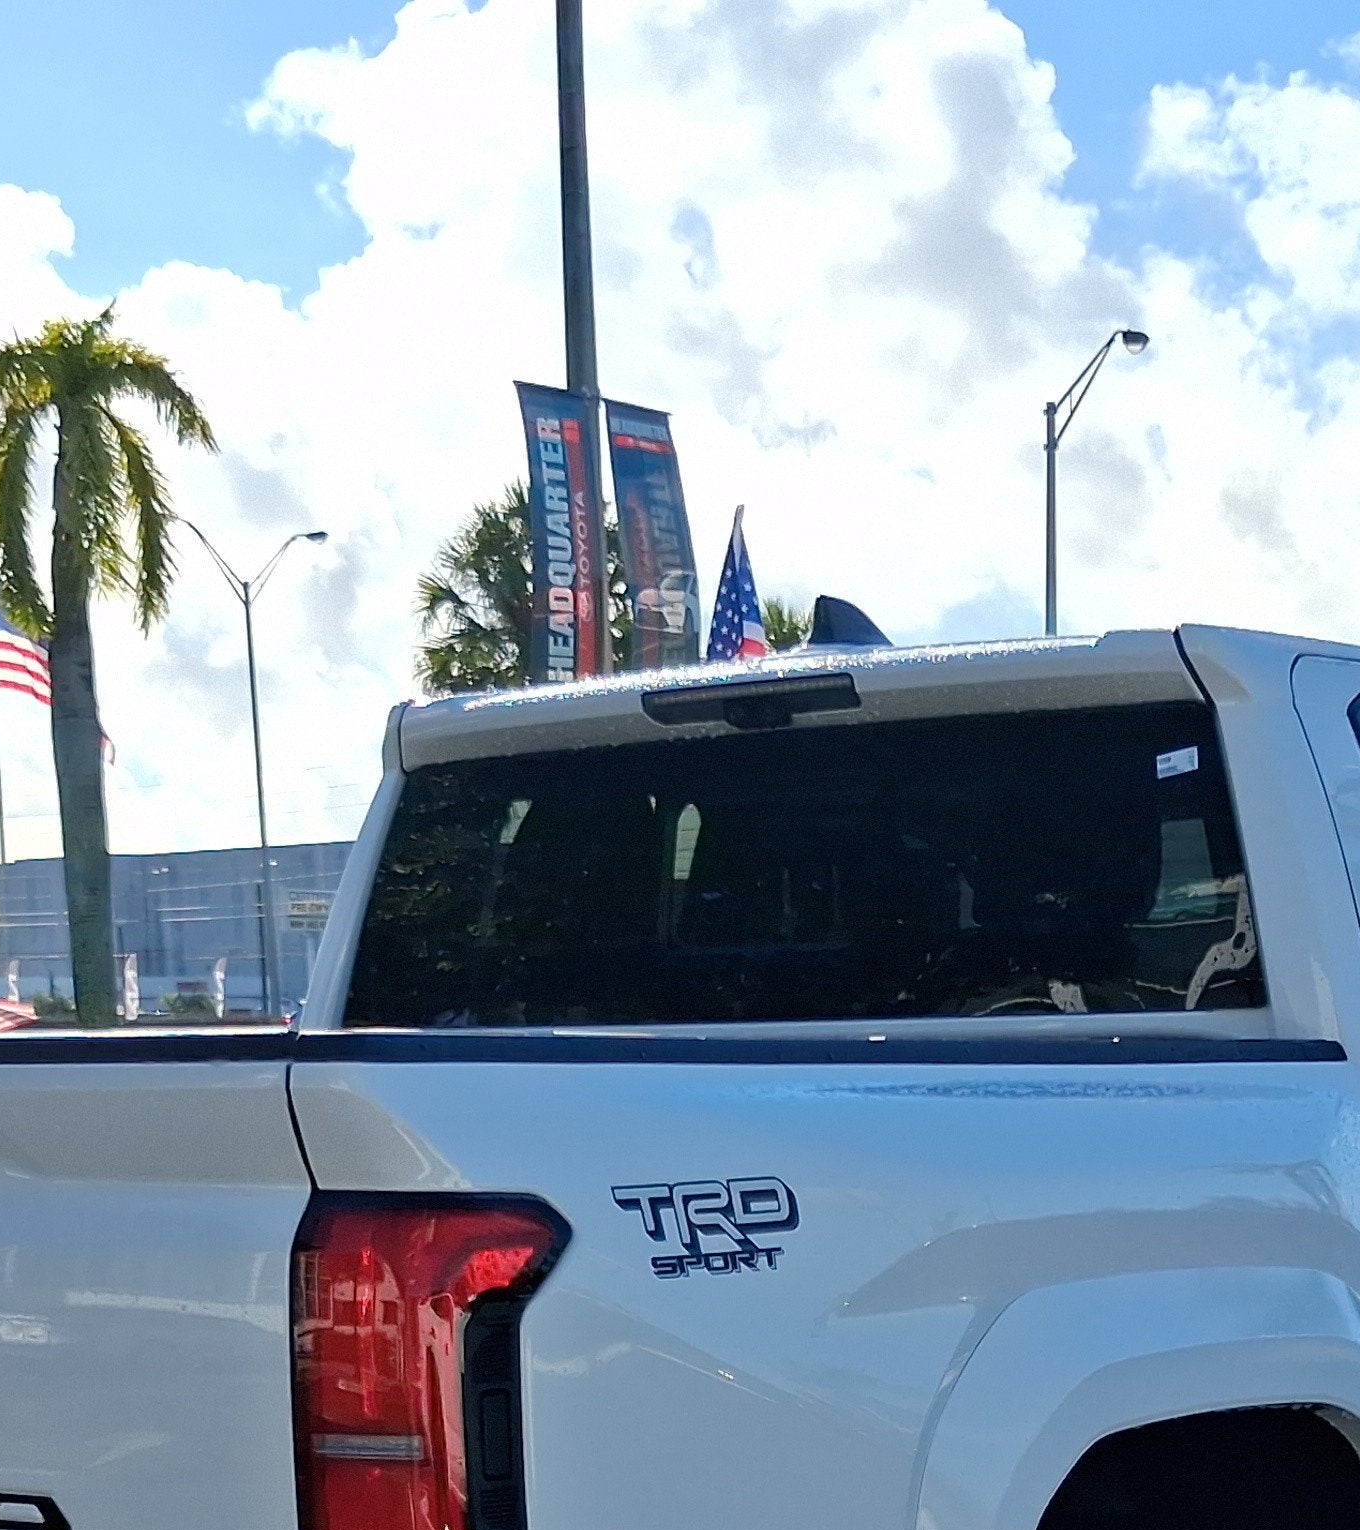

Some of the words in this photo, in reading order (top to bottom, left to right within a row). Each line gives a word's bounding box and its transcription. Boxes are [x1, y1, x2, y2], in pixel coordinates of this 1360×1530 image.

[536, 417, 576, 682] HEADQUARTER
[572, 491, 590, 588] TOYOTA
[610, 1176, 800, 1253] TRD
[650, 1247, 785, 1279] SPORT
